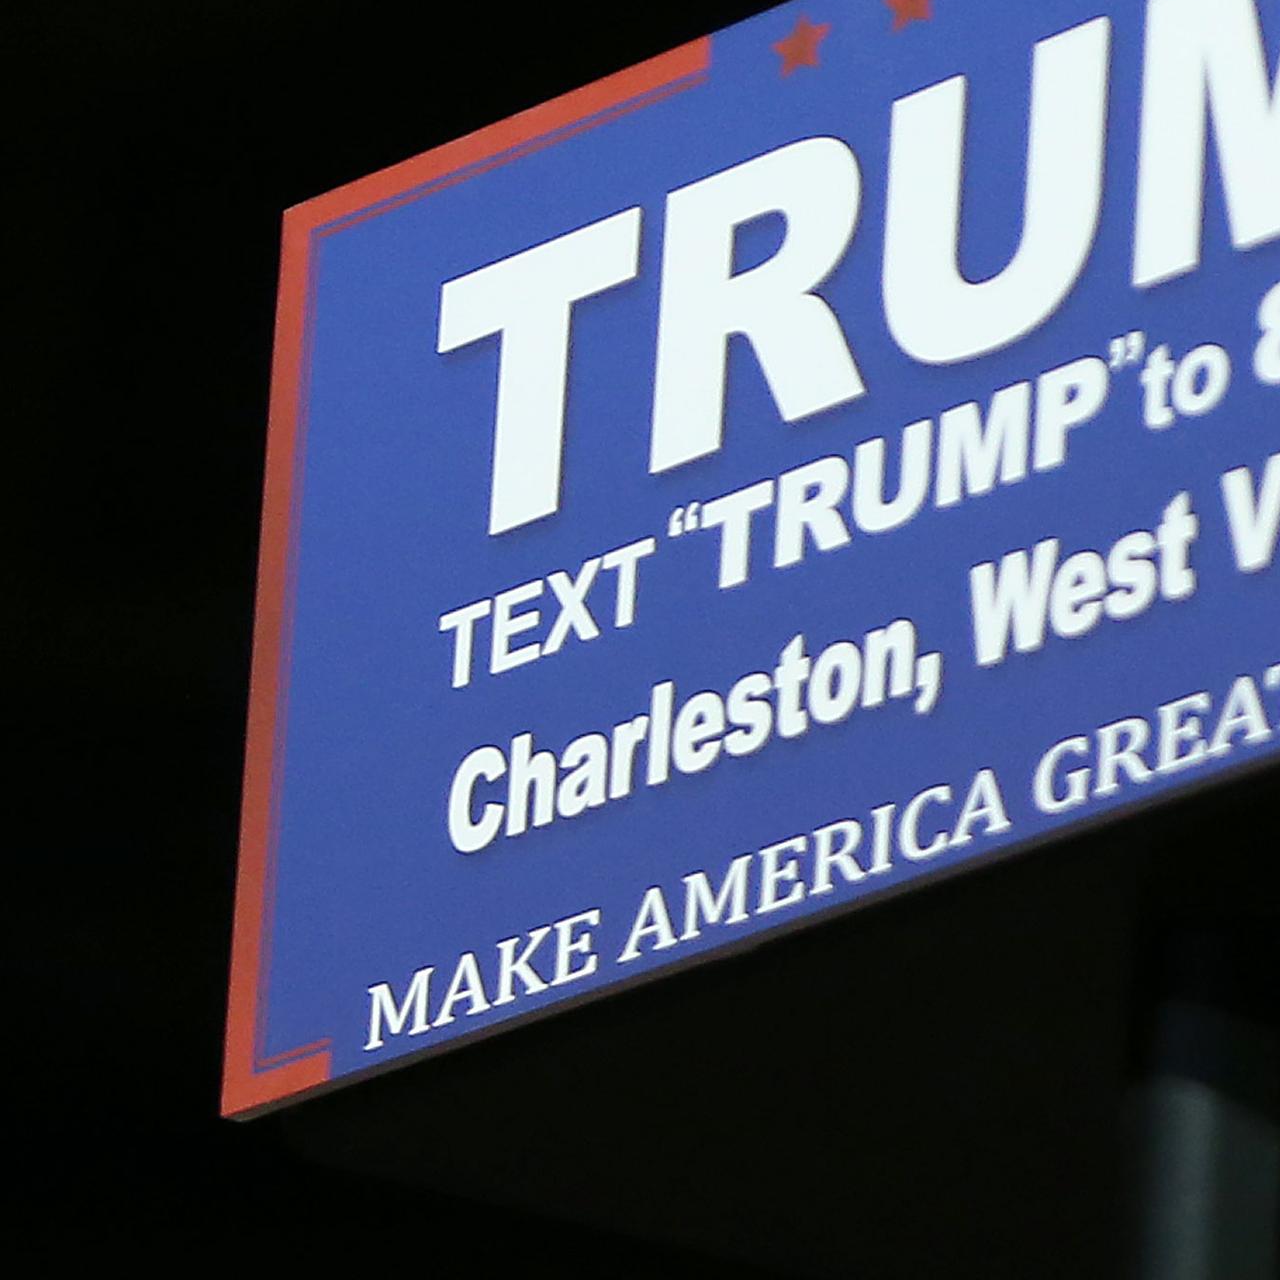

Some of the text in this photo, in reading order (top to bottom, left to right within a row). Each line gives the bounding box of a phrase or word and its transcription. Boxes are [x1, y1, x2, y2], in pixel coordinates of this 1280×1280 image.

[439, 537, 656, 688] TEXT
[448, 618, 943, 853] Charleston,
[968, 491, 1200, 667] West
[363, 908, 601, 1052] MAKE
[616, 768, 1012, 965] AMERICA
